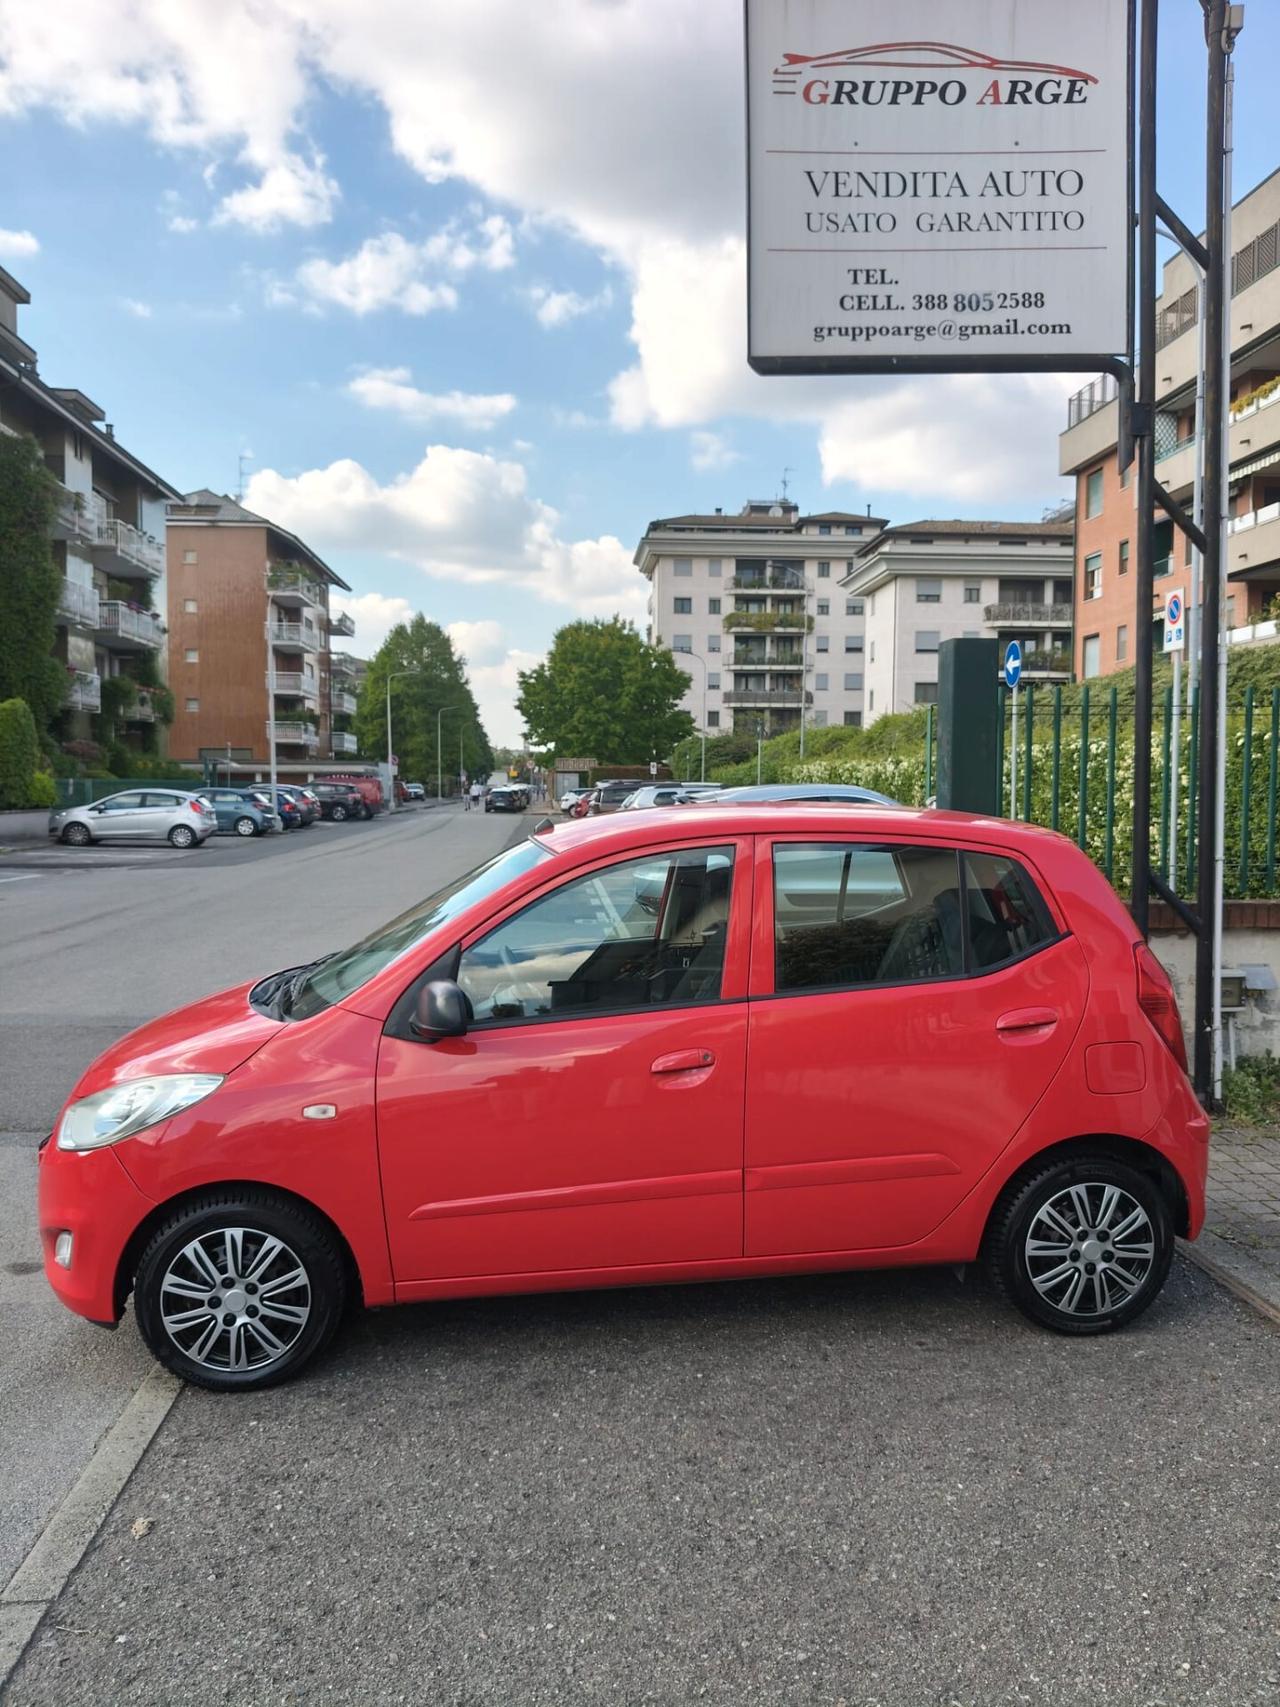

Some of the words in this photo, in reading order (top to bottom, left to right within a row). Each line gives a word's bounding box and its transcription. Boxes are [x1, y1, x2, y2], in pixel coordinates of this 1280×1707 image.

[802, 79, 967, 106] GRUPPO
[976, 78, 1089, 105] ARGE
[804, 170, 969, 198] VENDITA
[979, 169, 1084, 198] AUTO
[805, 211, 897, 233] USATO
[915, 210, 1085, 233] GARANTITO
[848, 268, 900, 285] TEL.
[839, 294, 905, 311] CELL.
[912, 293, 949, 311] 388
[953, 292, 995, 313] 805
[997, 292, 1046, 309] 2588
[813, 318, 1073, 342] gruppoarge@gmail.com
